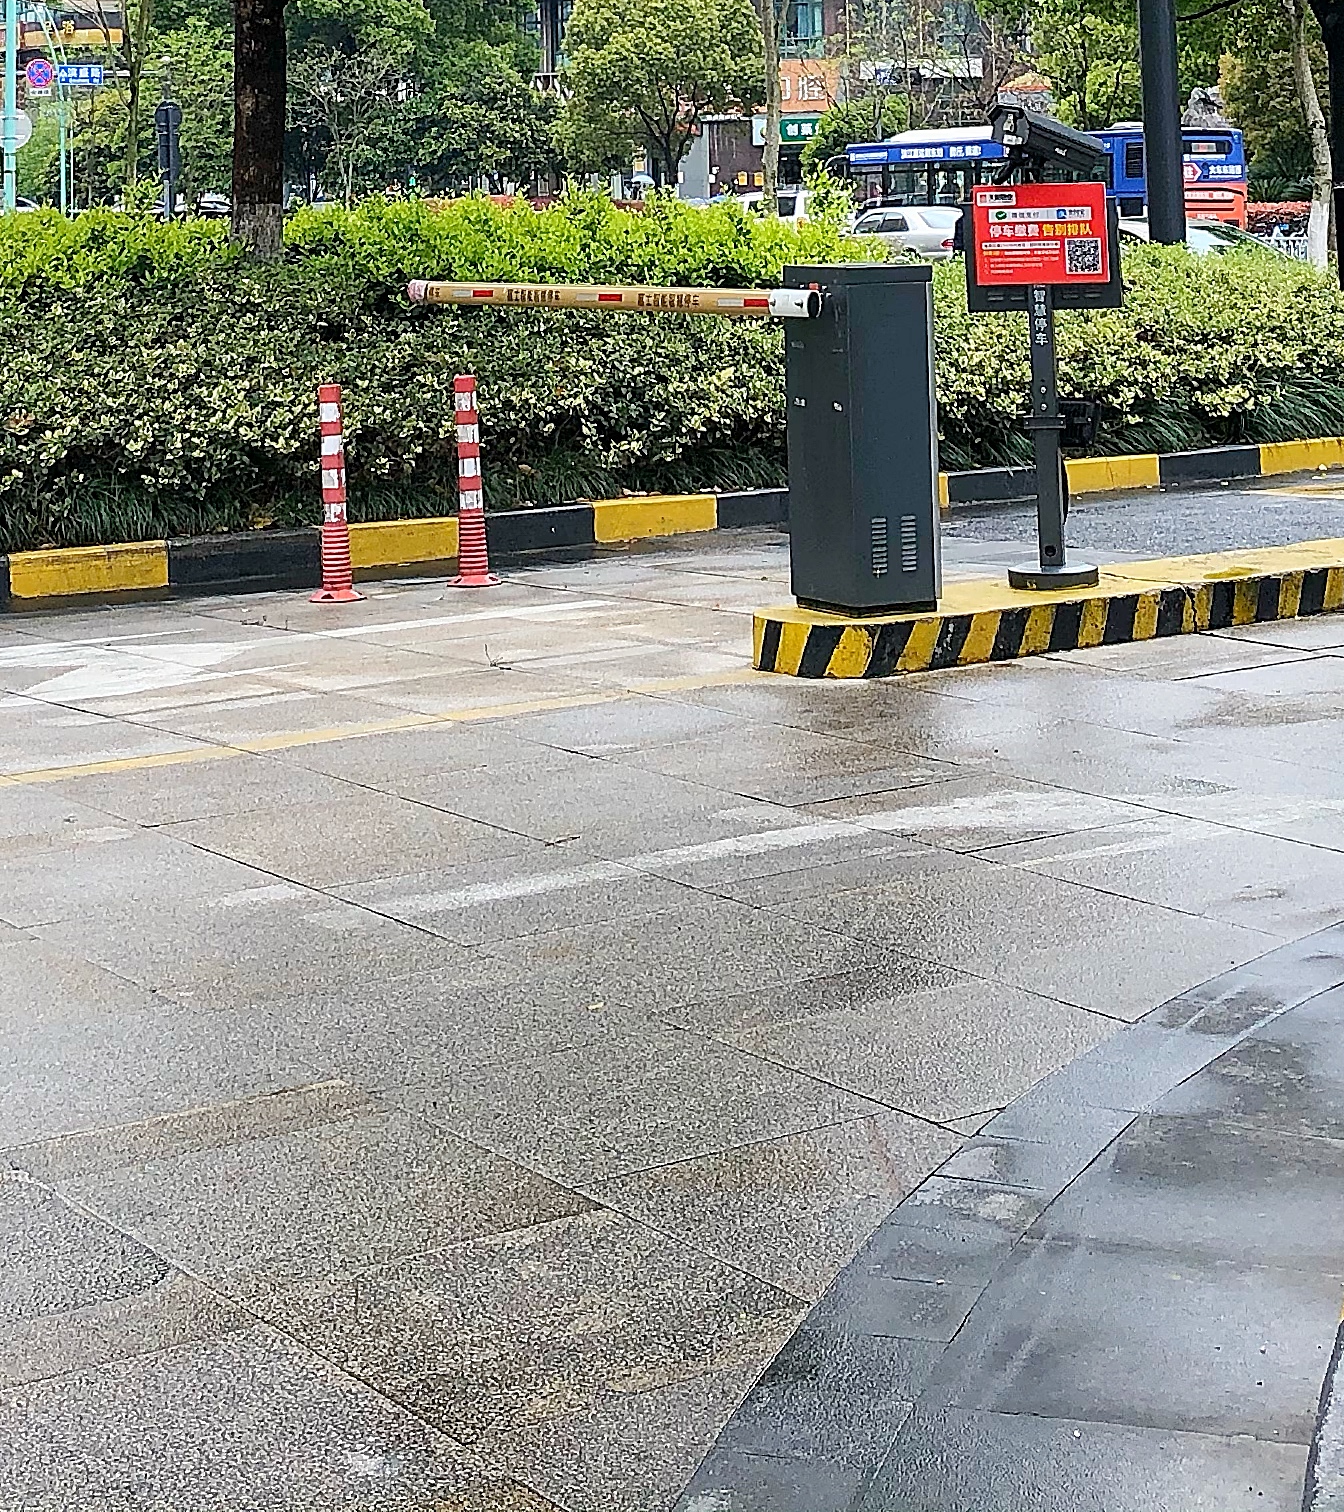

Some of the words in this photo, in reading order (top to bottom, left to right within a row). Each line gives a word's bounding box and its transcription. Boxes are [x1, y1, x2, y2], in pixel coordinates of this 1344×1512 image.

[989, 223, 1039, 238] 停车缴费
[1042, 222, 1093, 237] 告别排队
[1033, 284, 1049, 346] 智慧停车
